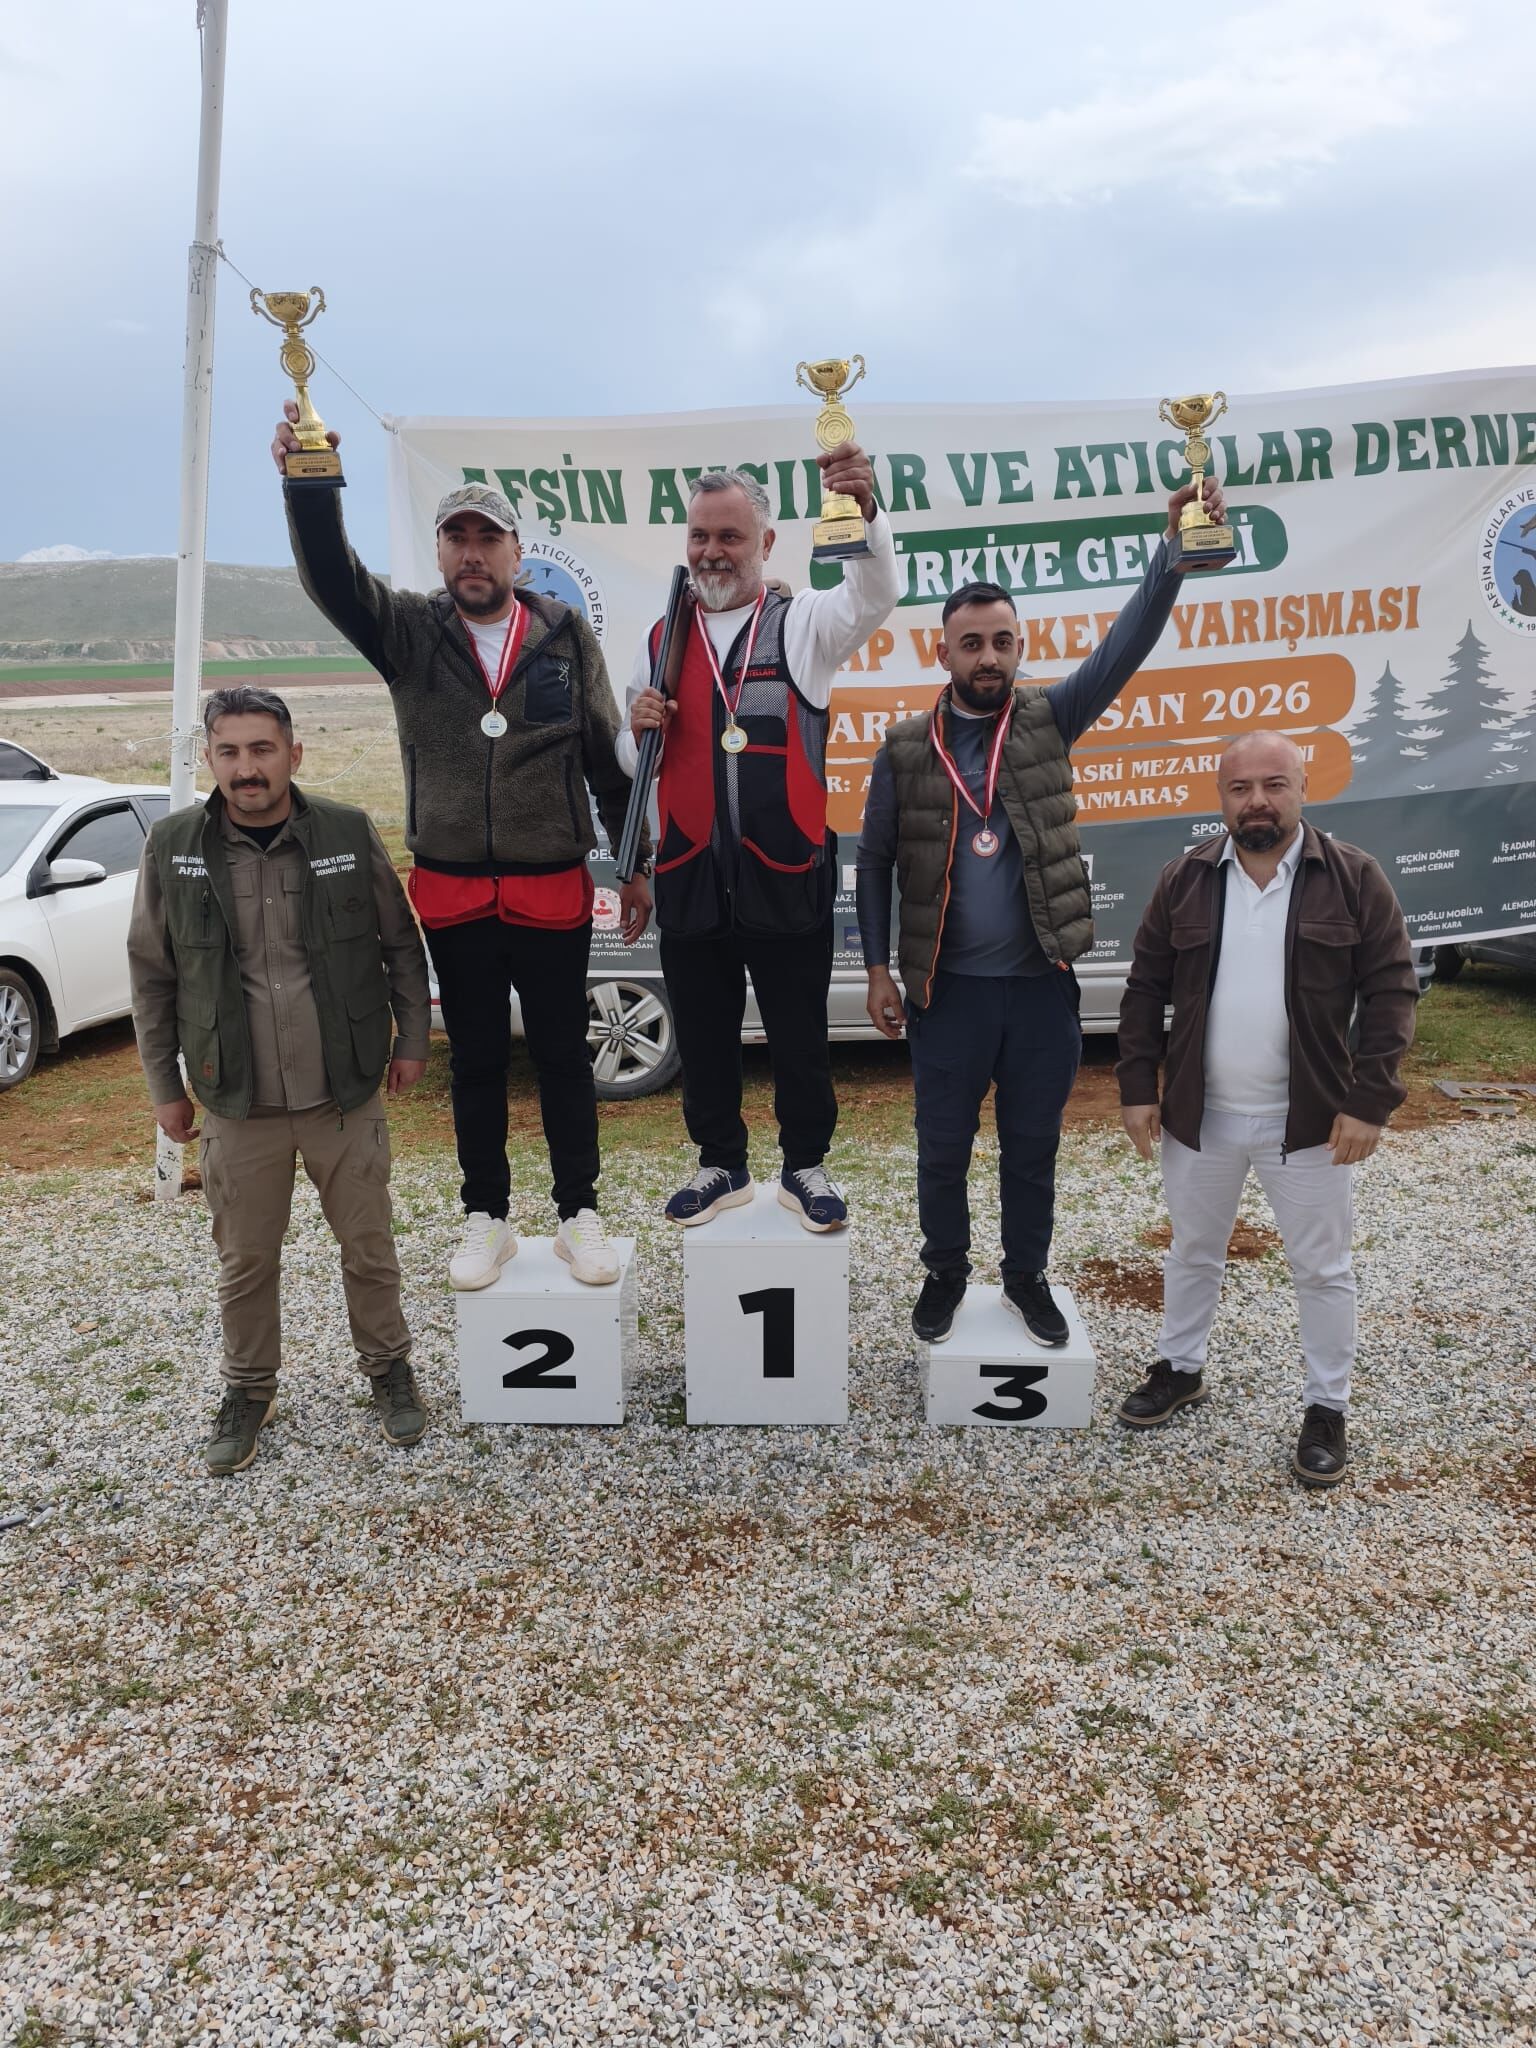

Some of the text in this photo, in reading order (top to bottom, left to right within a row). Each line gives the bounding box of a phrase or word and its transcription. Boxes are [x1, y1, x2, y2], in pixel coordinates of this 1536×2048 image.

[946, 451, 1034, 507] VE
[1481, 489, 1535, 609] AFŞİN AVCILAR VE
[894, 533, 1065, 600] RKİYE
[588, 590, 604, 638] DERN
[1171, 585, 1421, 652] YARIŞMASI
[1087, 692, 1187, 733] SAN
[1201, 681, 1311, 722] 2026
[1074, 785, 1189, 810] ANMARAŞ
[1395, 848, 1460, 865] SEÇKİN DÖNER
[1401, 861, 1454, 875] Ahmet CERAN
[1492, 854, 1517, 864] Ahmet
[1091, 893, 1125, 902] LENDER
[1446, 906, 1483, 919] MOBİLYA
[591, 931, 657, 941] AYMAKLIĞI
[1418, 920, 1462, 933] Adem KARA
[1081, 950, 1117, 958] LENDER
[1095, 940, 1121, 948] TORS
[738, 1288, 795, 1378] 1
[502, 1329, 577, 1389] 2
[971, 1365, 1049, 1421] 3
